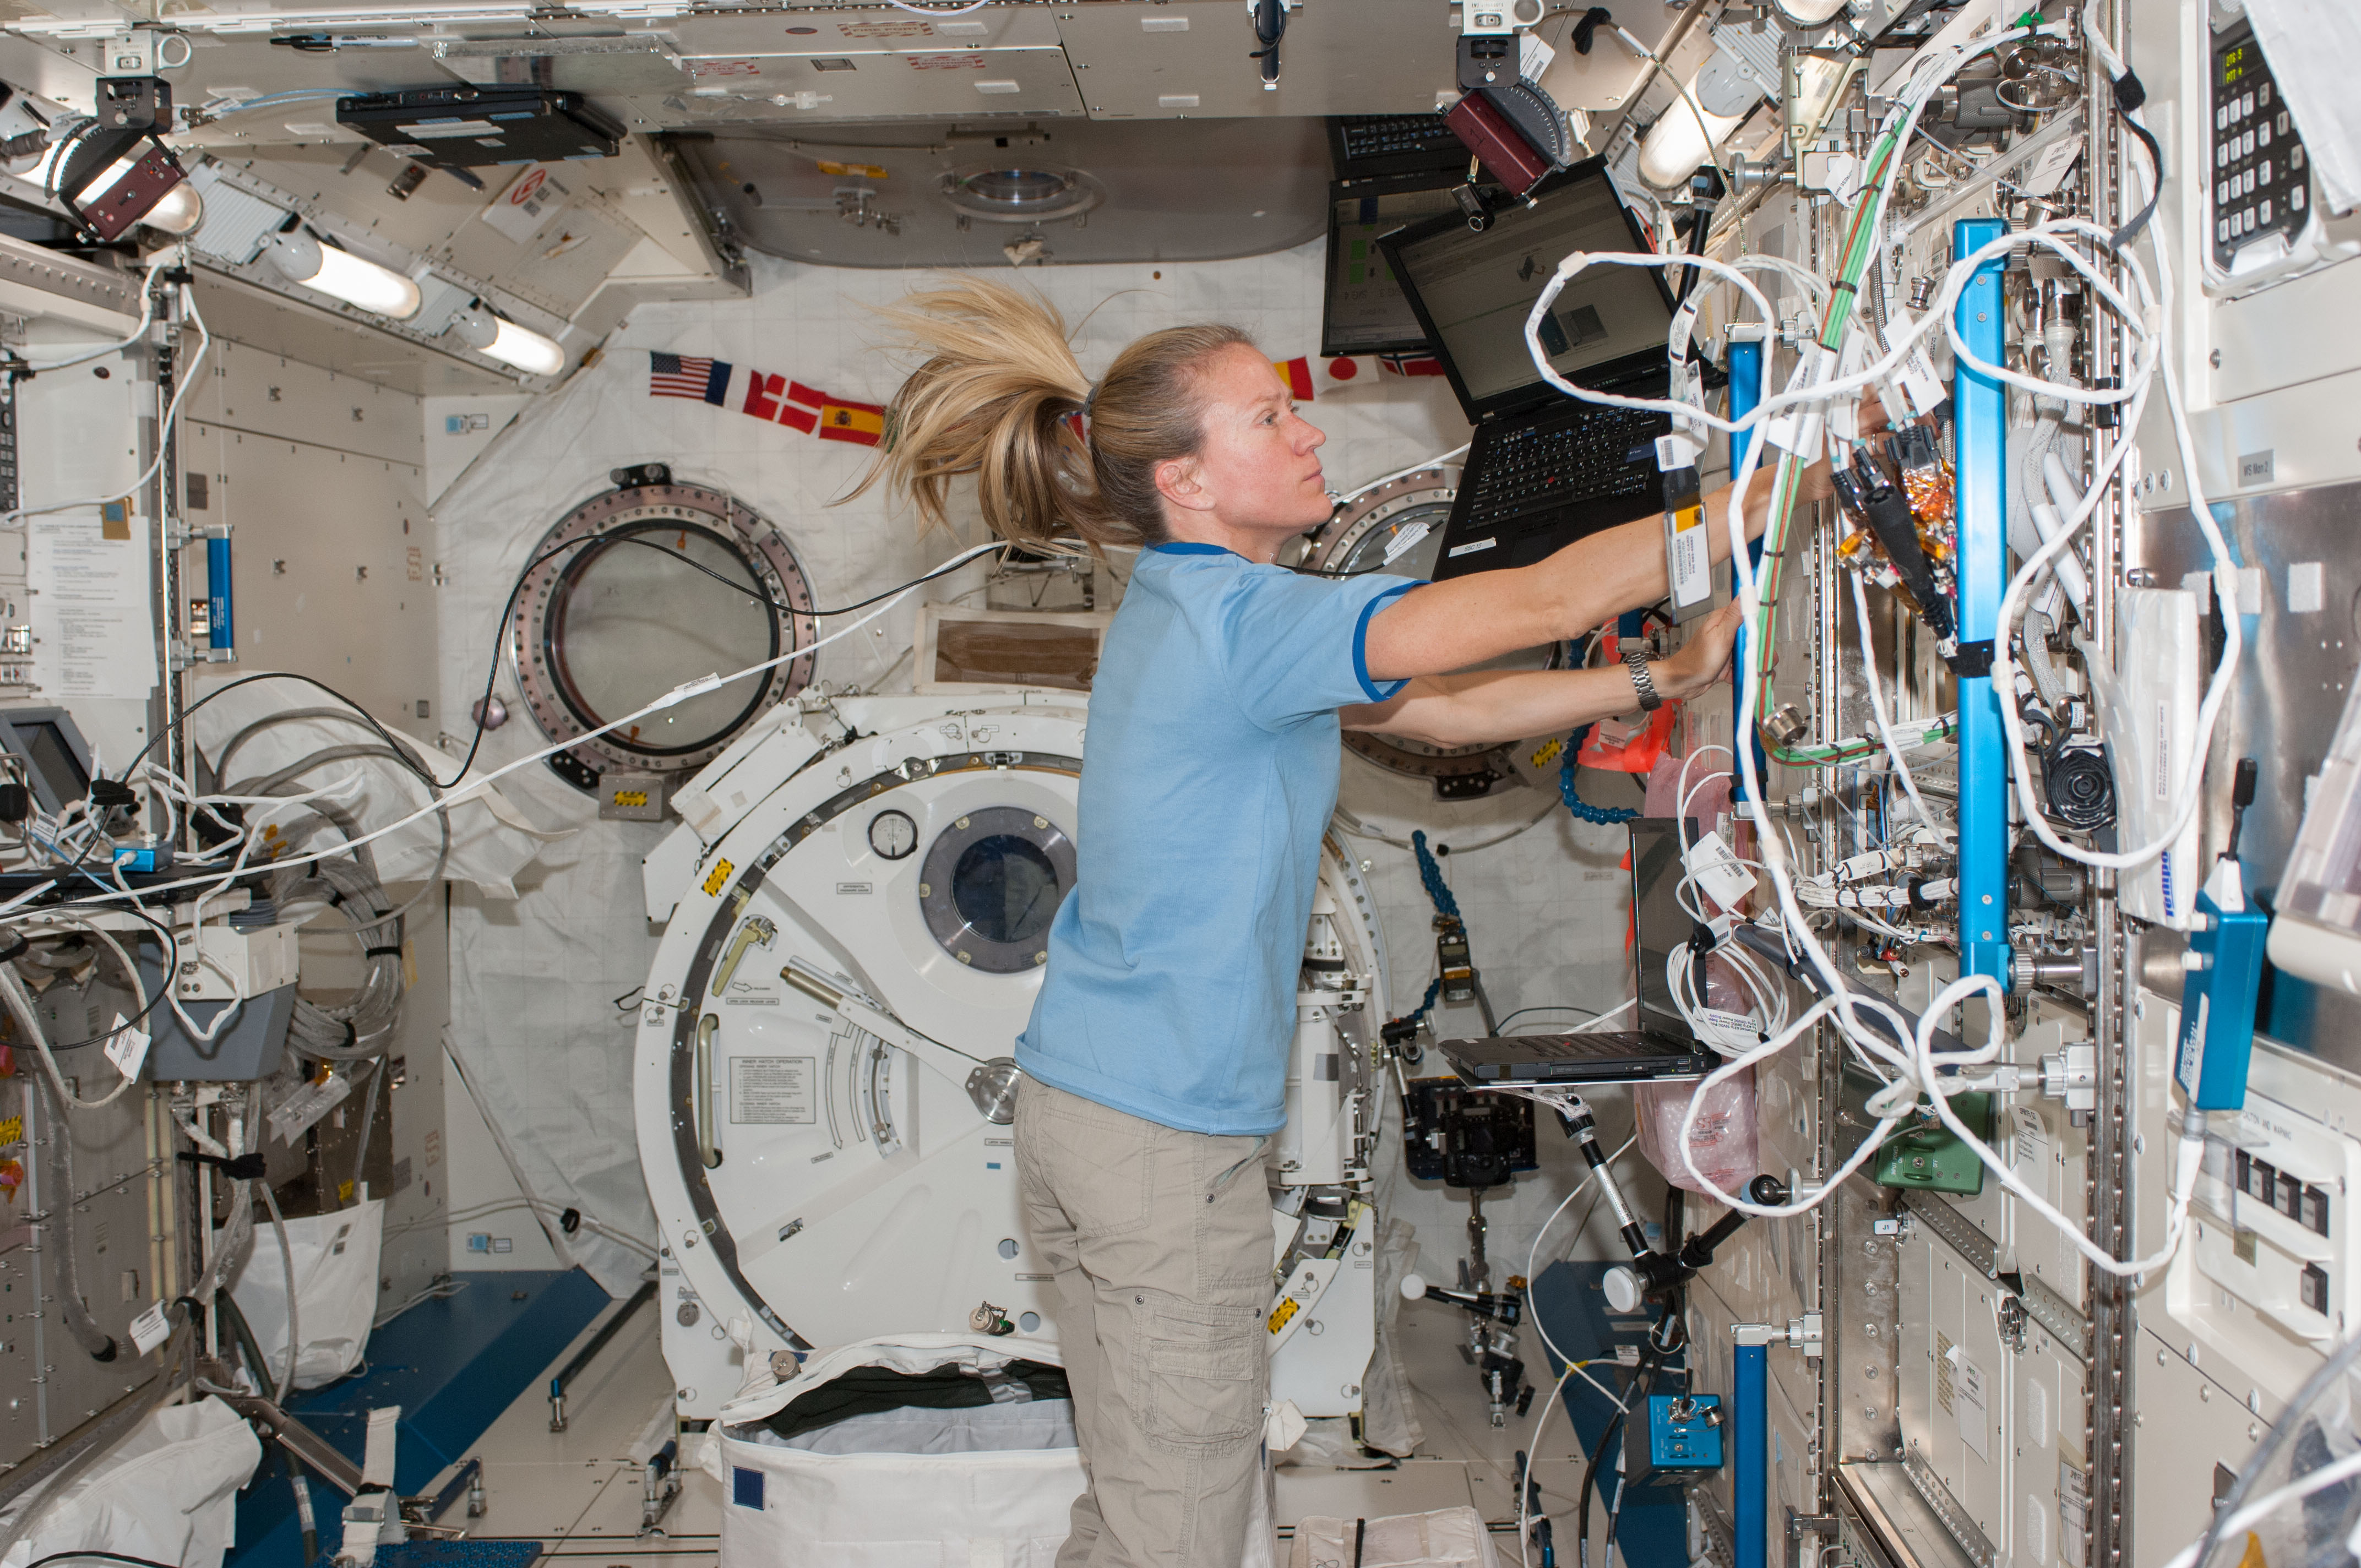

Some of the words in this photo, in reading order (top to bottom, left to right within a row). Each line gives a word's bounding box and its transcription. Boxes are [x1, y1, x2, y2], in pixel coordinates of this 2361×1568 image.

[2244, 464, 2251, 476] WS
[2253, 463, 2264, 474] Mon
[1464, 544, 1475, 552] SSC
[2262, 1119, 2271, 1130] AND
